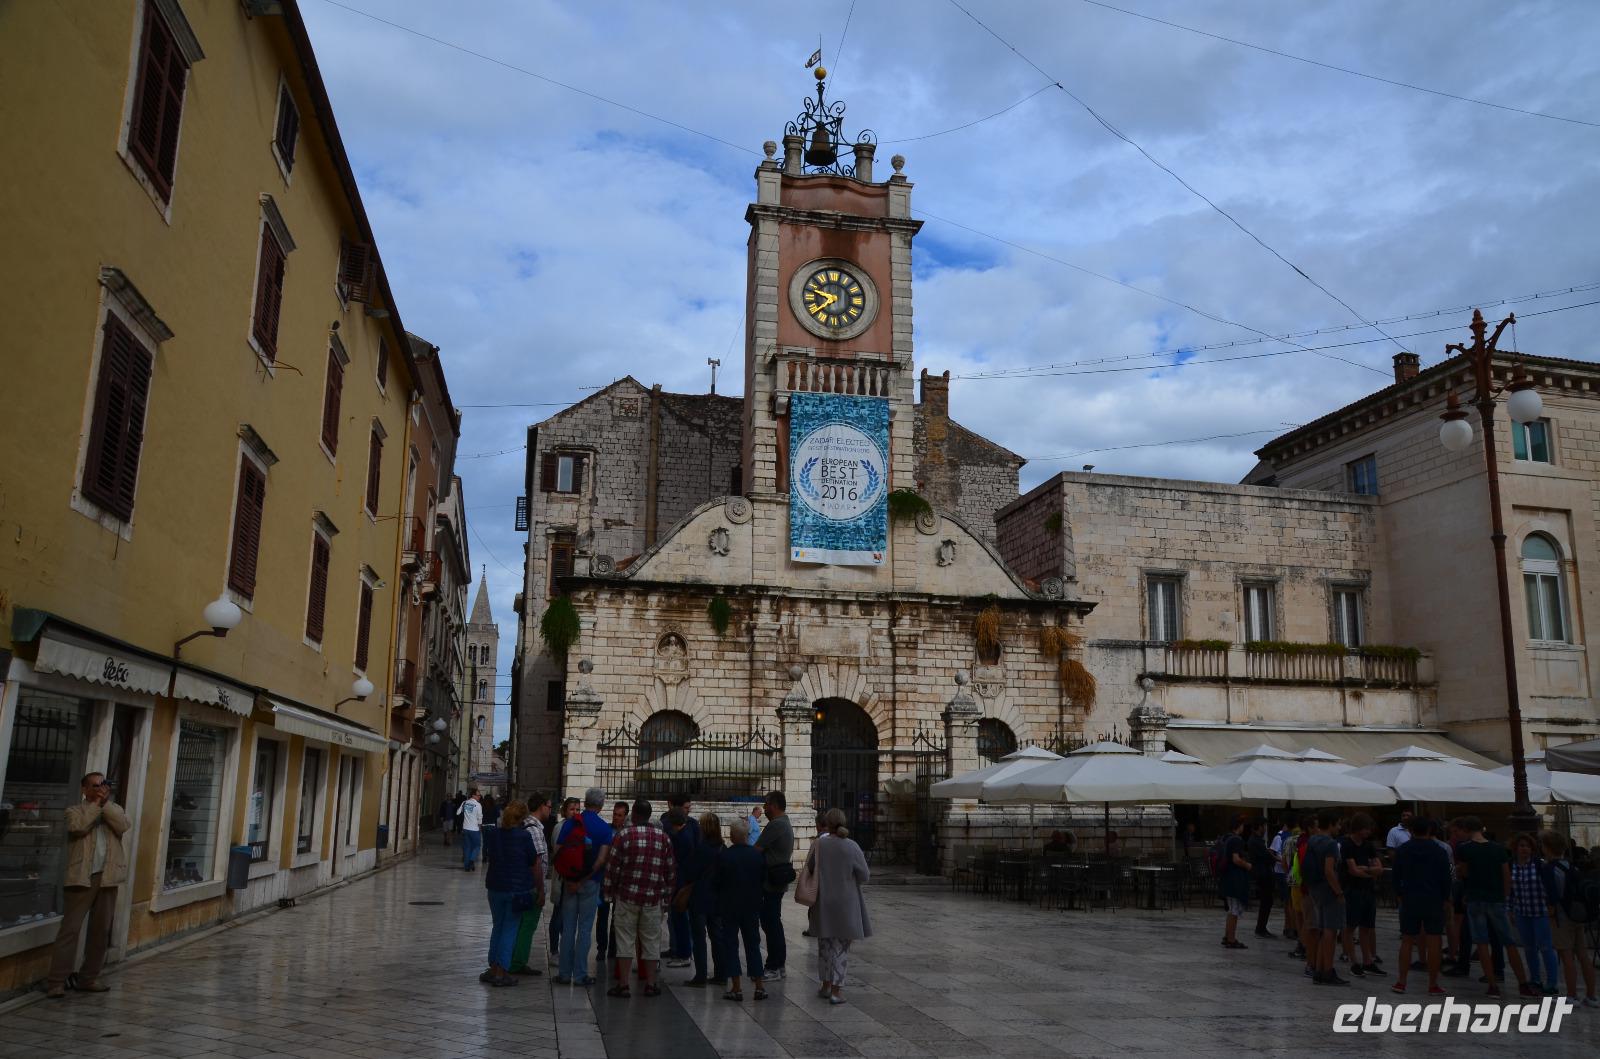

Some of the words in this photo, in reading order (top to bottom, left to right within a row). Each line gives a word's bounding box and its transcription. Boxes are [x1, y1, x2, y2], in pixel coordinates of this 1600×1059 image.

[809, 436, 834, 445] ZADAR
[836, 437, 870, 447] ELECTED
[821, 458, 859, 467] EUROPEAN
[821, 465, 858, 480] BEST
[821, 484, 858, 501] 2016
